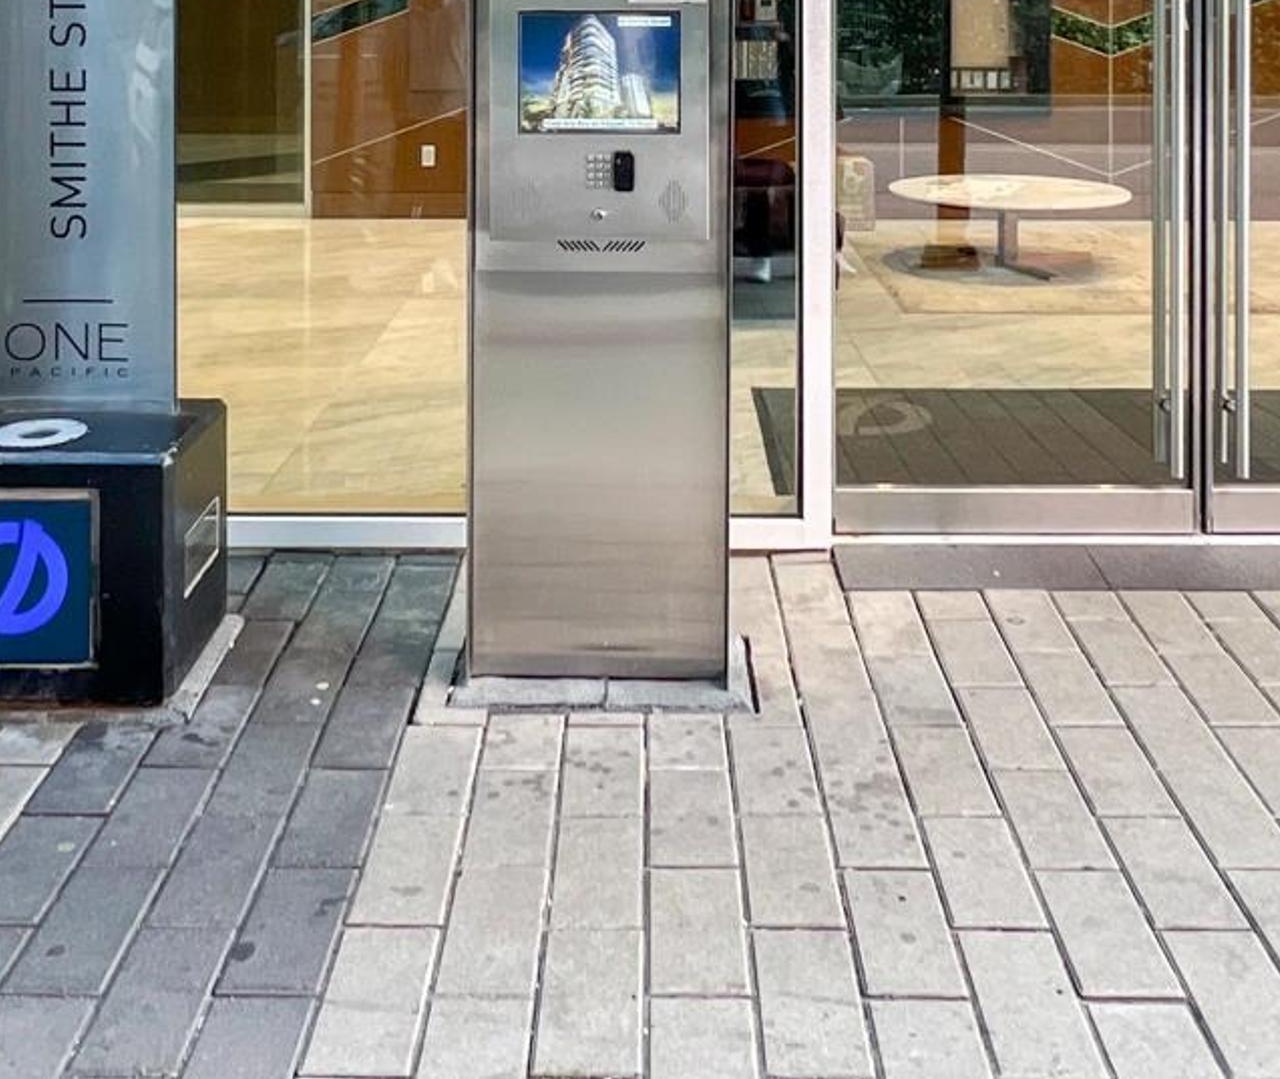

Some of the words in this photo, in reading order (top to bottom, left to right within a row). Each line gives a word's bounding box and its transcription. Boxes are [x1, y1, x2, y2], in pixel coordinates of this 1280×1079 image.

[48, 68, 87, 240] SMITHE
[4, 321, 130, 362] ONE
[10, 367, 130, 379] PACIFIC
